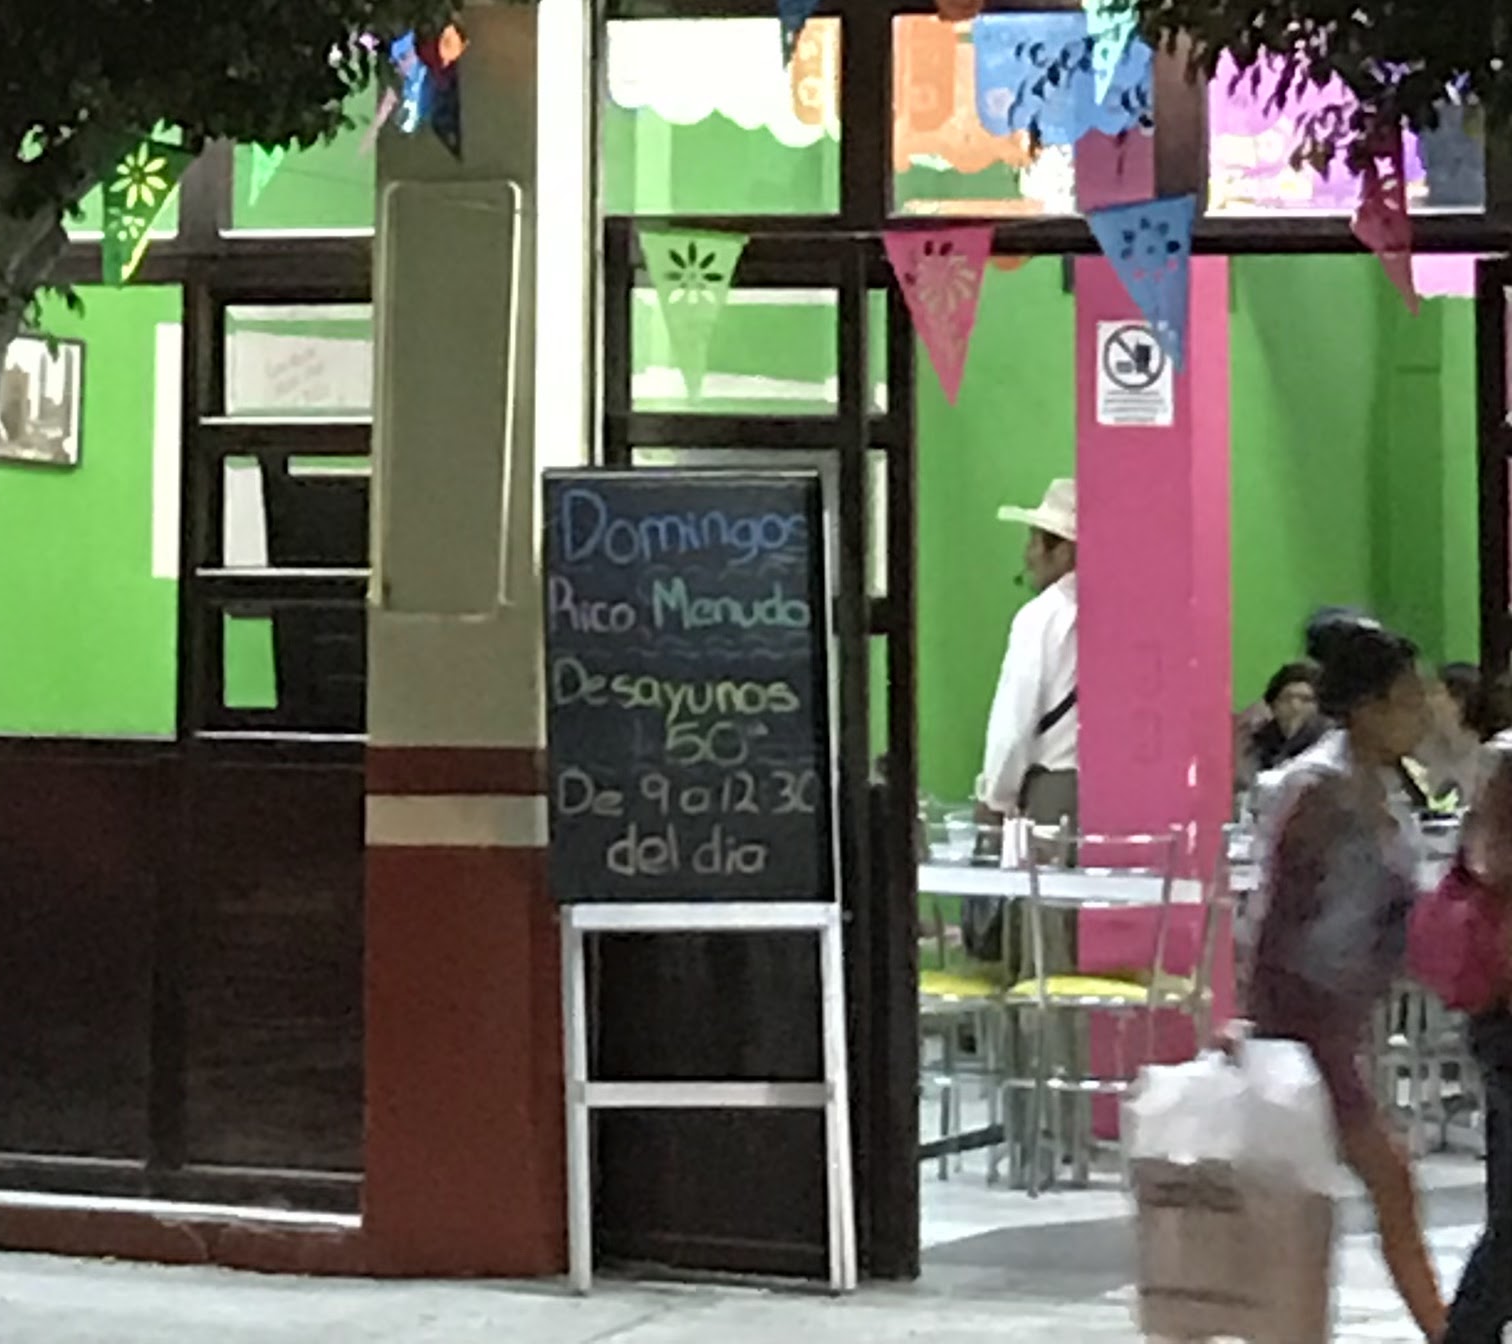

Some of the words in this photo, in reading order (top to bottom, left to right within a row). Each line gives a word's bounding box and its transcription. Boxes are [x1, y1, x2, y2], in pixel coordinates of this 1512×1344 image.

[549, 576, 636, 633] Rico
[653, 576, 811, 630] Menudo
[553, 657, 800, 722] Desayunos
[557, 767, 624, 816] De
[639, 772, 670, 815] 9
[607, 822, 680, 876] del
